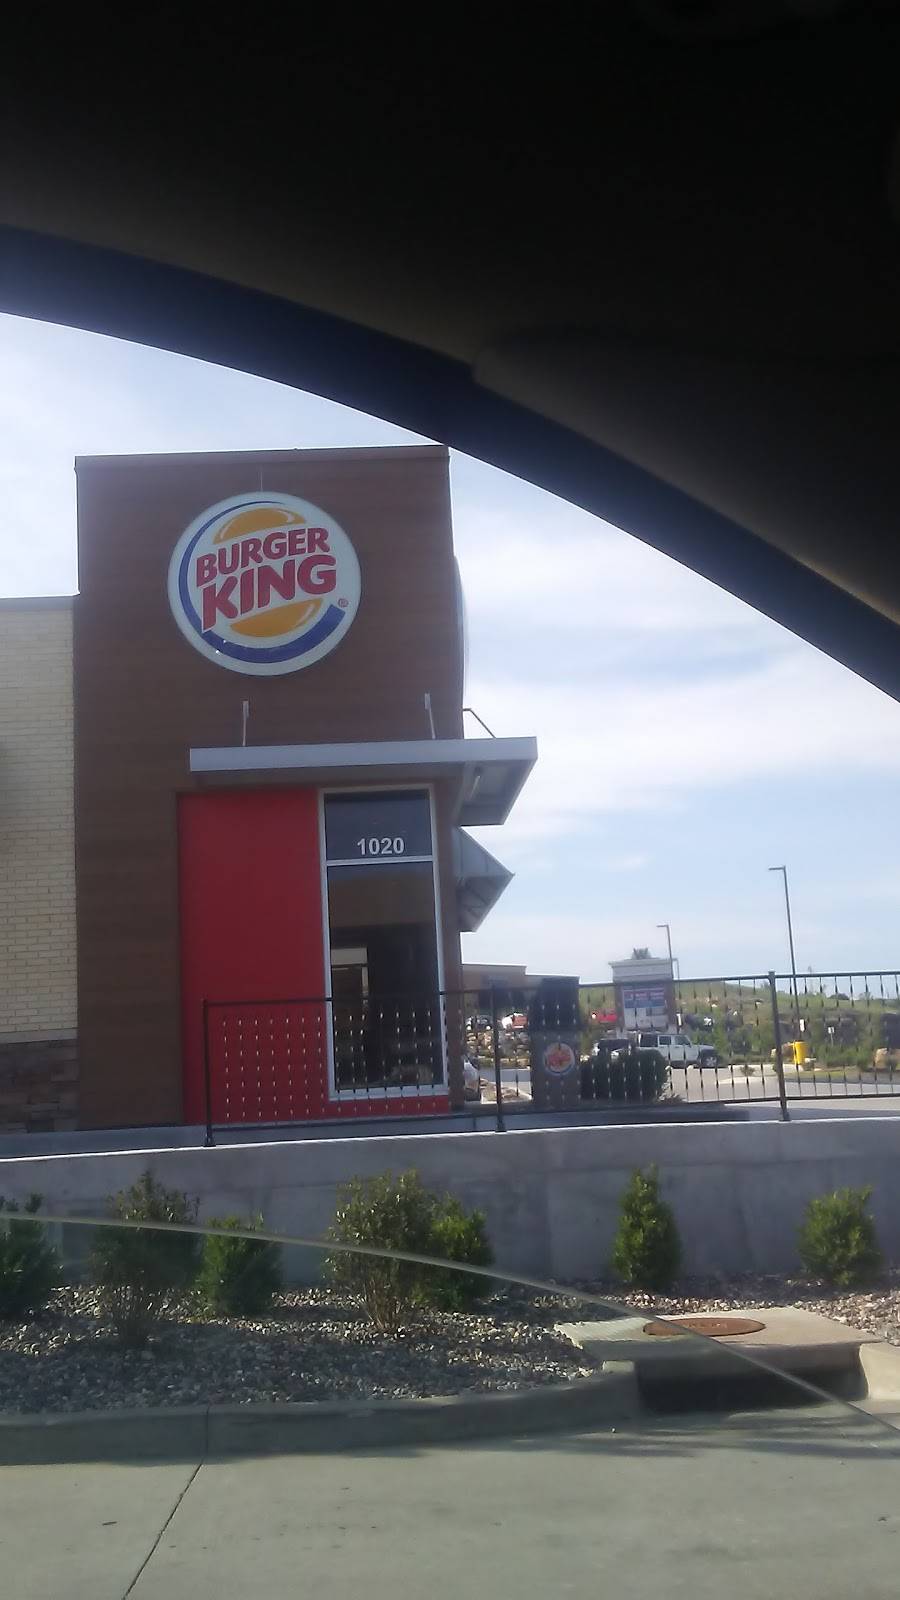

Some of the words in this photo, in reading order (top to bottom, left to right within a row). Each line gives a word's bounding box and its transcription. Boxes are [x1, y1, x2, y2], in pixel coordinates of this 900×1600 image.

[196, 527, 330, 587] BURGER
[202, 554, 336, 632] KING
[356, 837, 405, 856] 1020
